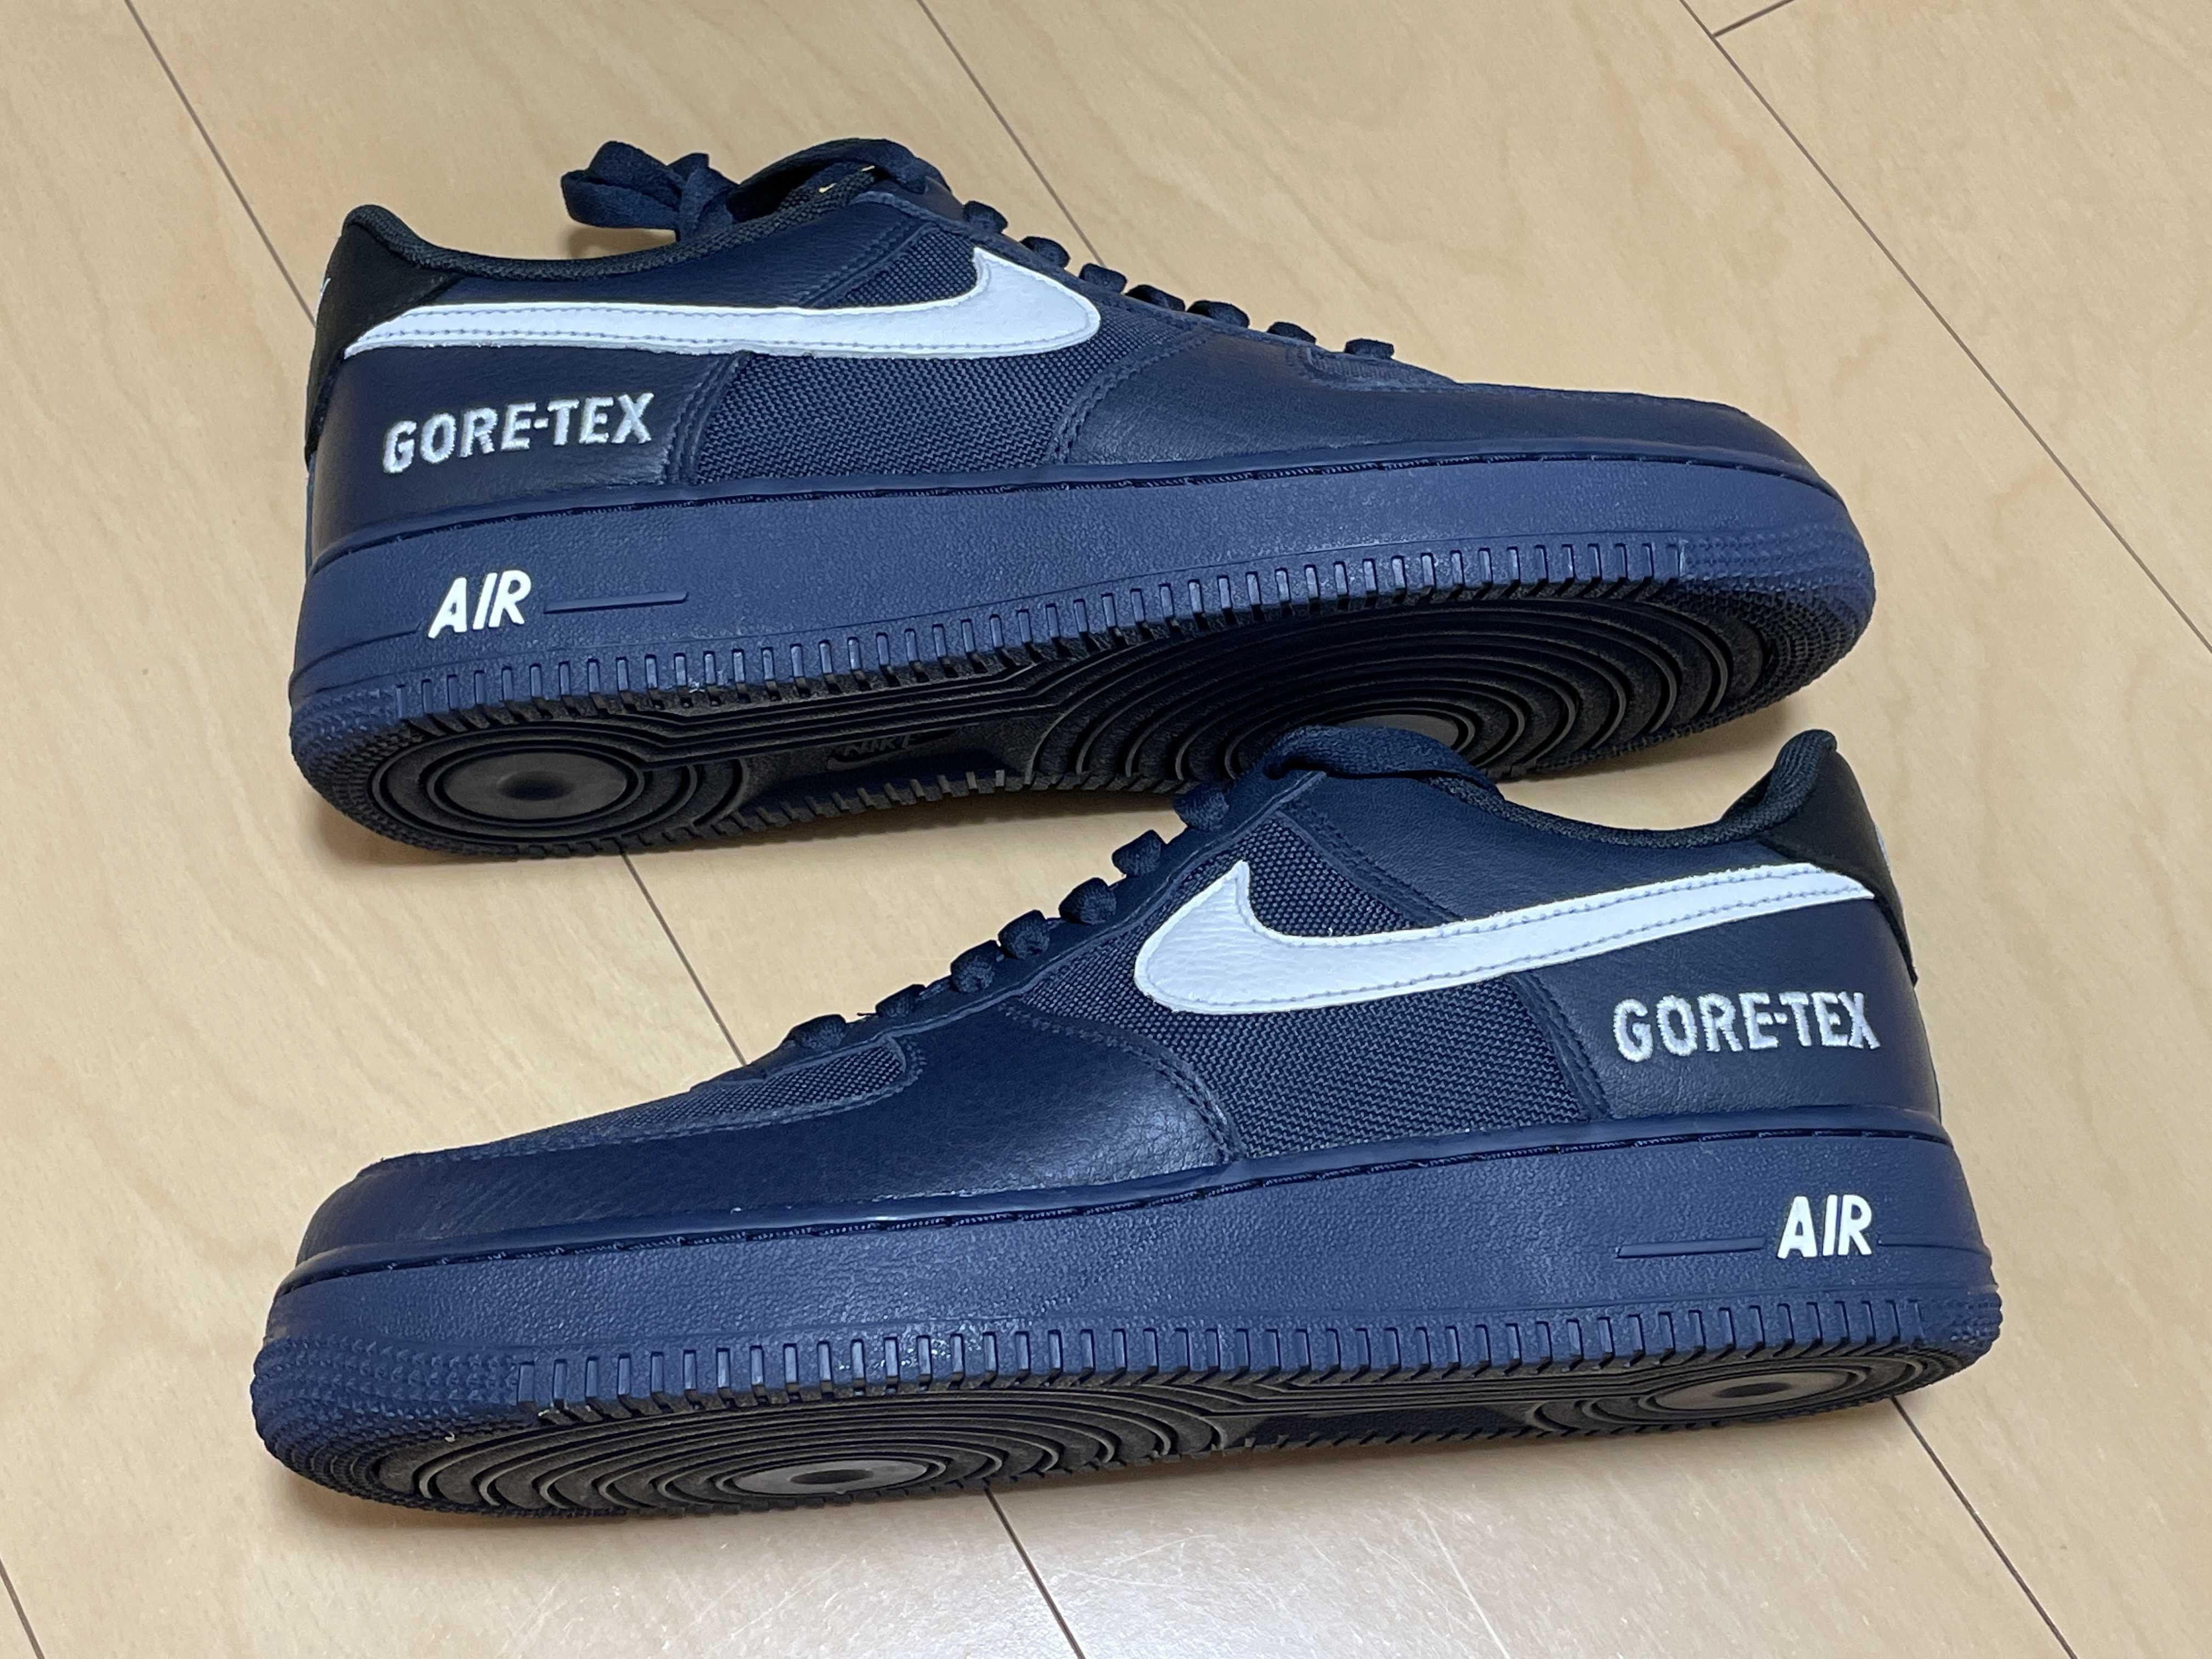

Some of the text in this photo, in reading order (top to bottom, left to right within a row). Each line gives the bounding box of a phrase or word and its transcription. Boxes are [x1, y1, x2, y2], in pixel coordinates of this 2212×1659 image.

[382, 392, 654, 474] GORE-TEX
[427, 569, 532, 639] AIR
[1613, 991, 1881, 1063] GORE-TEX
[1776, 1194, 1873, 1260] AIR
